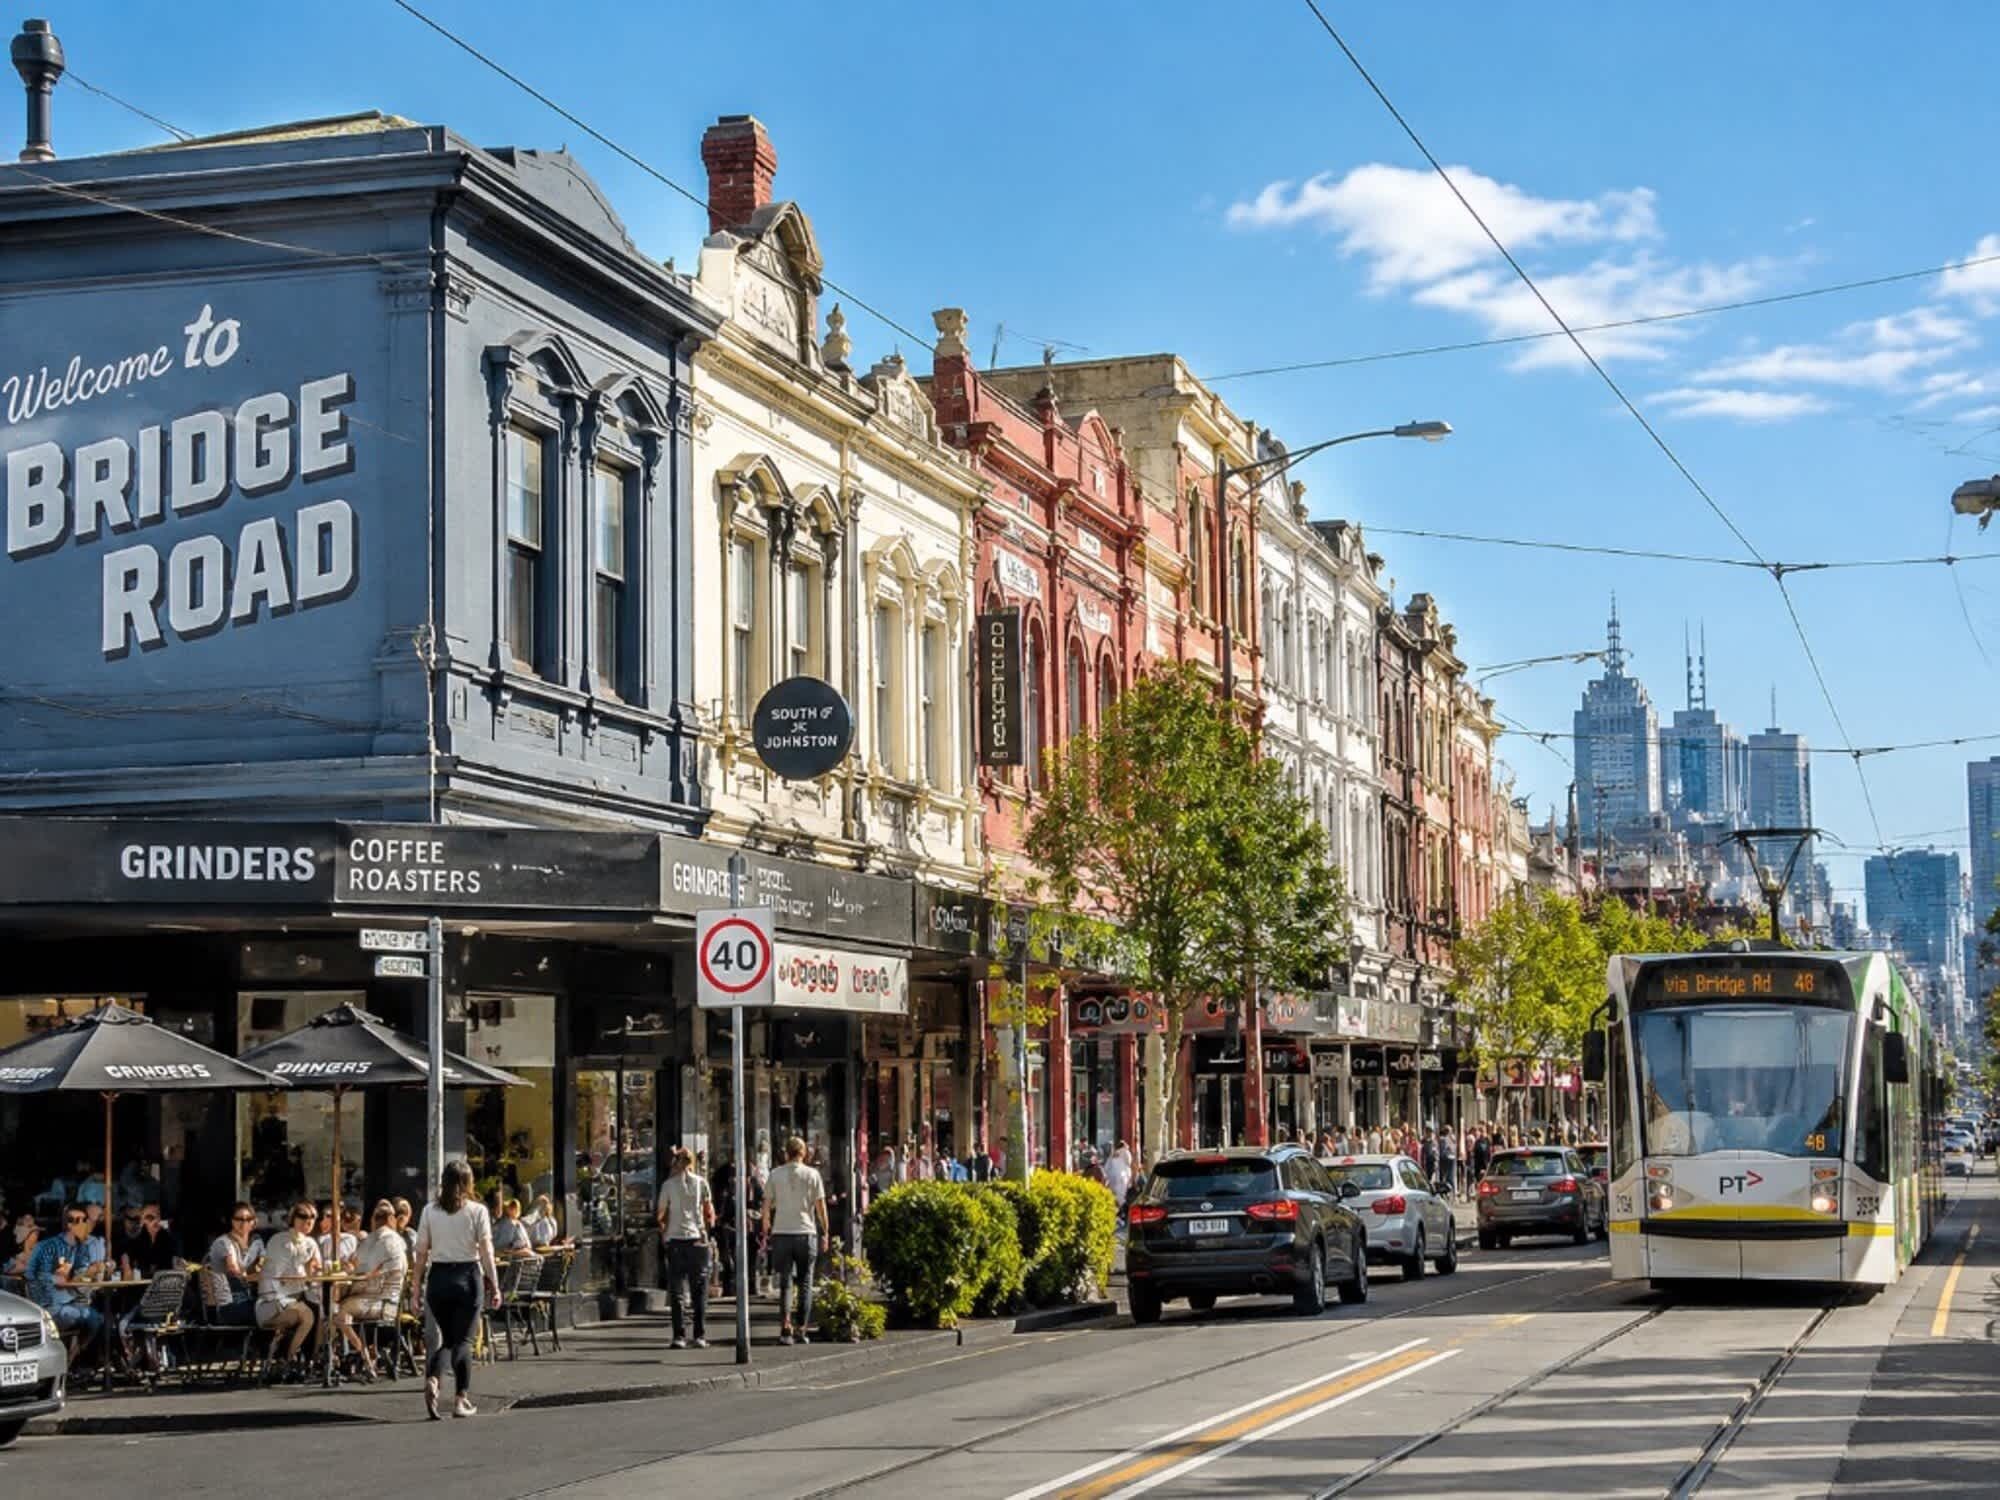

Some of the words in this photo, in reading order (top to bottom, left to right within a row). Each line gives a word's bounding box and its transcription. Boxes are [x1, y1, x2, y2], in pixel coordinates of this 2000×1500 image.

[2, 344, 173, 425] Welcome
[184, 303, 241, 368] to
[7, 373, 354, 562] BRIDGE
[101, 499, 358, 662] ROAD
[770, 707, 817, 720] SOUTH
[763, 735, 839, 749] JOHNSTON
[120, 845, 316, 882] GRINDERS
[350, 838, 446, 865] COFFEE
[350, 868, 481, 894] ROASTERS
[710, 940, 757, 972] 40
[1664, 975, 1689, 993] via
[1696, 973, 1745, 997] Bridge
[1793, 972, 1815, 993] 48
